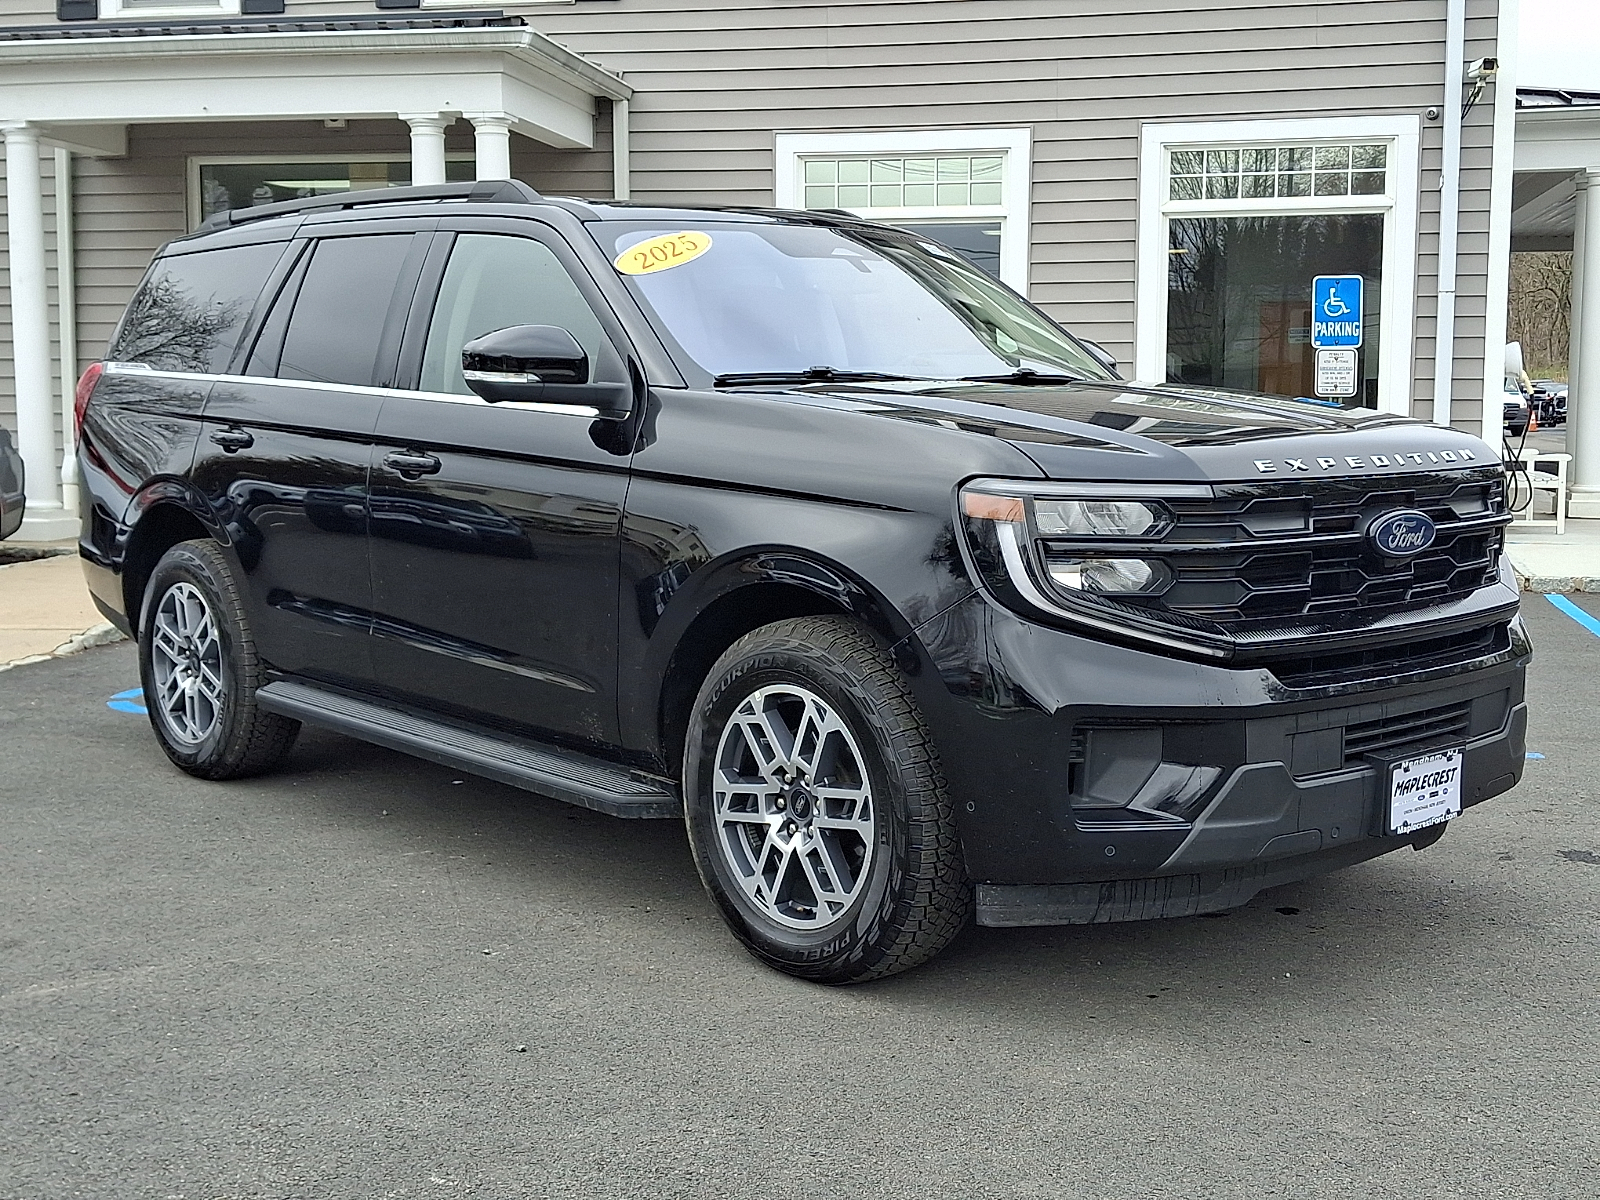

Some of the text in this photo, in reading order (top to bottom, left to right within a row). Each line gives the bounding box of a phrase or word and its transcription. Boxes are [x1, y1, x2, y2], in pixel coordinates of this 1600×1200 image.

[634, 235, 698, 270] 2025
[1315, 321, 1360, 337] PARKING
[1253, 448, 1476, 473] EXPEDITION
[1388, 520, 1426, 549] Ford
[704, 655, 788, 717] SCORPION
[1394, 767, 1458, 797] MAPLECREST
[1397, 812, 1458, 834] MaplecrestFord.com
